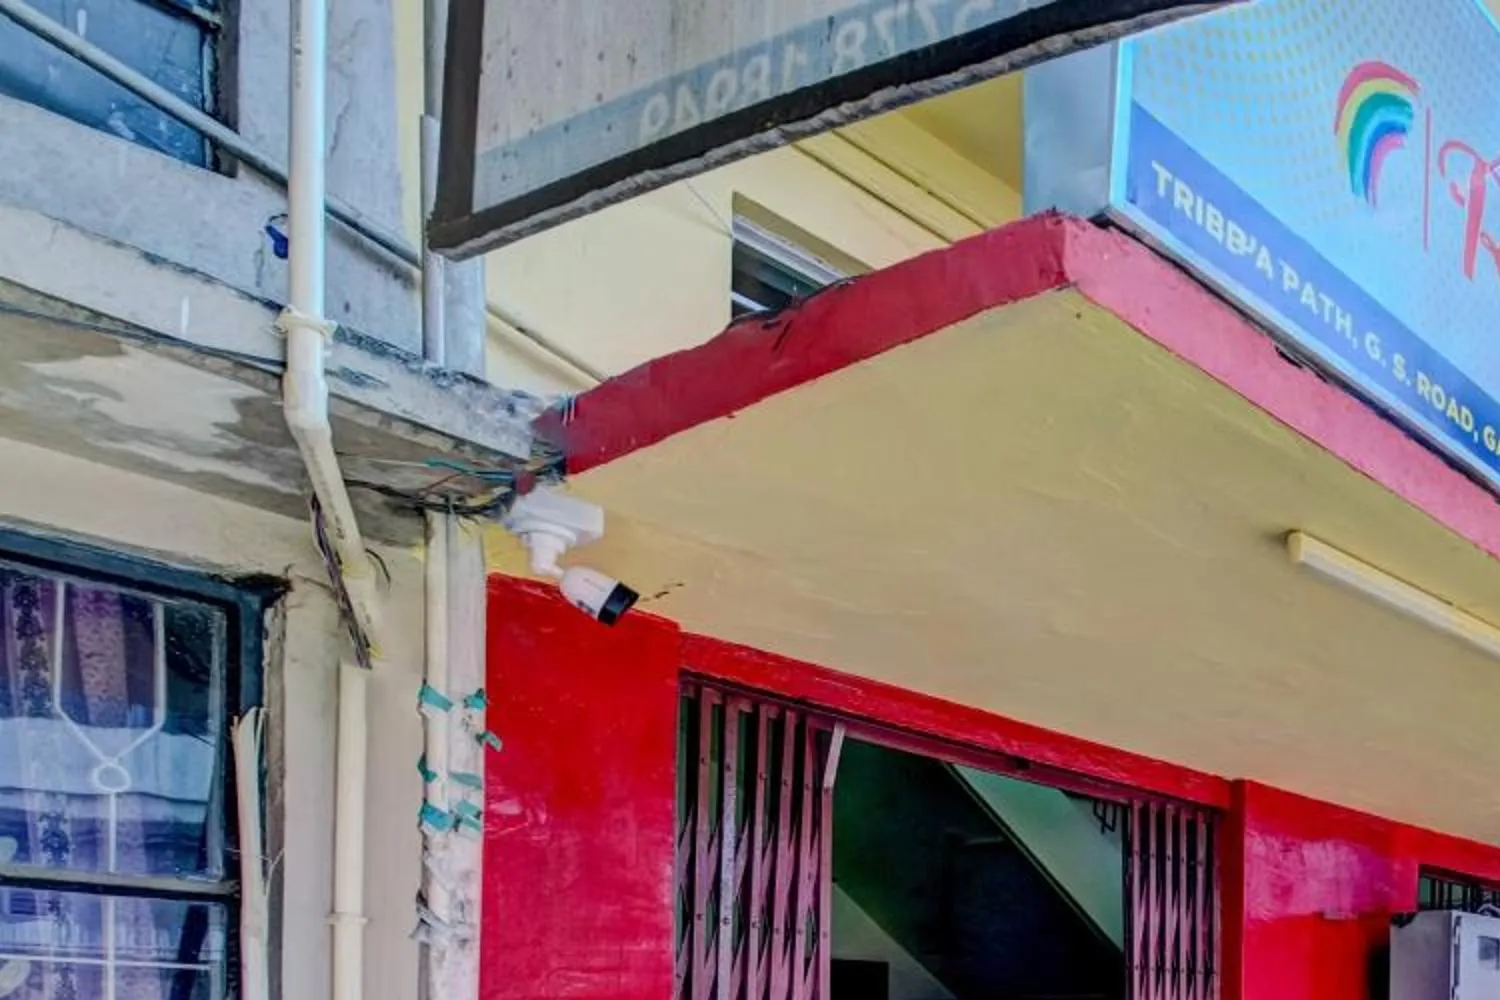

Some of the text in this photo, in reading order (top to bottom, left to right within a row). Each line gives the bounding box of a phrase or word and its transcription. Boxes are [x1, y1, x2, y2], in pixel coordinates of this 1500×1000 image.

[1279, 257, 1359, 348] PATH,
[1364, 331, 1387, 367] G.
[1392, 353, 1411, 387] S.
[1416, 371, 1478, 442] ROAD,
